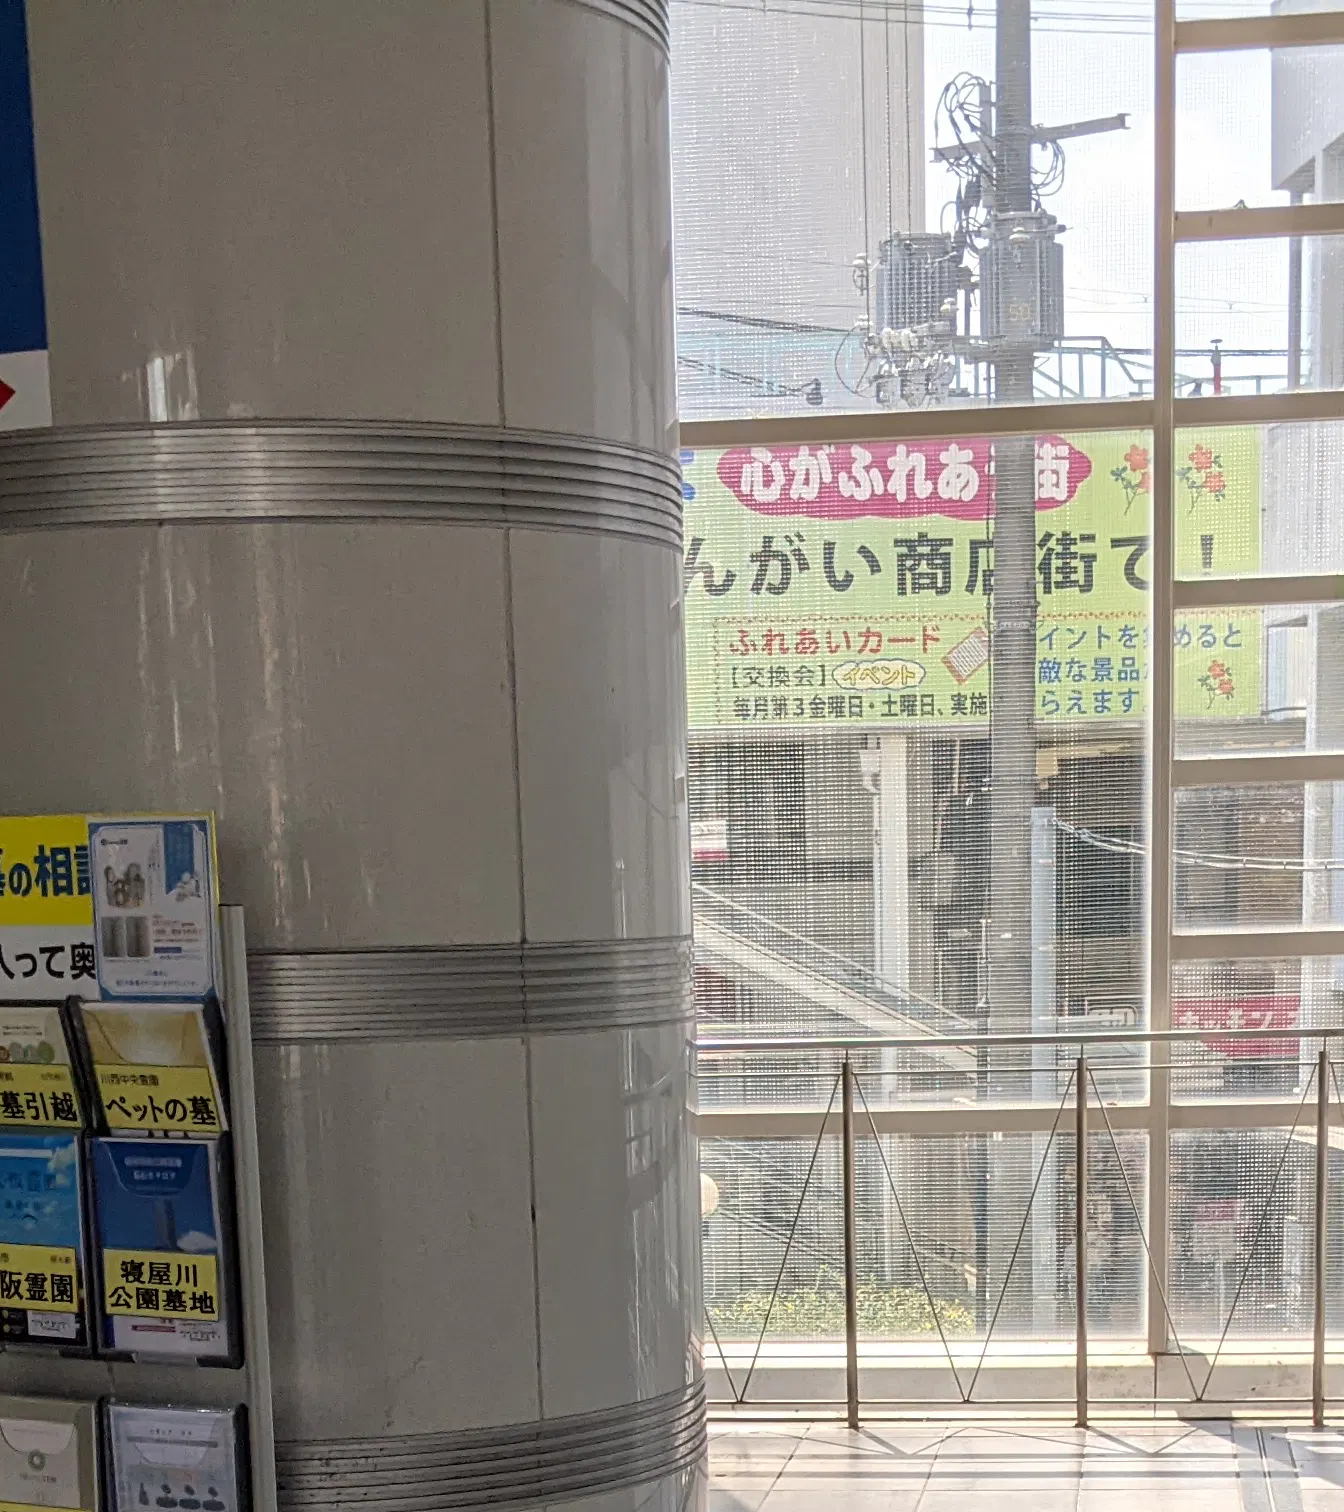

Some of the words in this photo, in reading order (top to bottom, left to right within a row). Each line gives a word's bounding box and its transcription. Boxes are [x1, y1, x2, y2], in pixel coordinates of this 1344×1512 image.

[729, 625, 940, 656] ふれあいカード
[843, 667, 916, 687] イベント
[105, 1095, 217, 1126] ペットの墓
[120, 1259, 198, 1288] 寝屋川
[108, 1286, 216, 1314] 公園墓地
